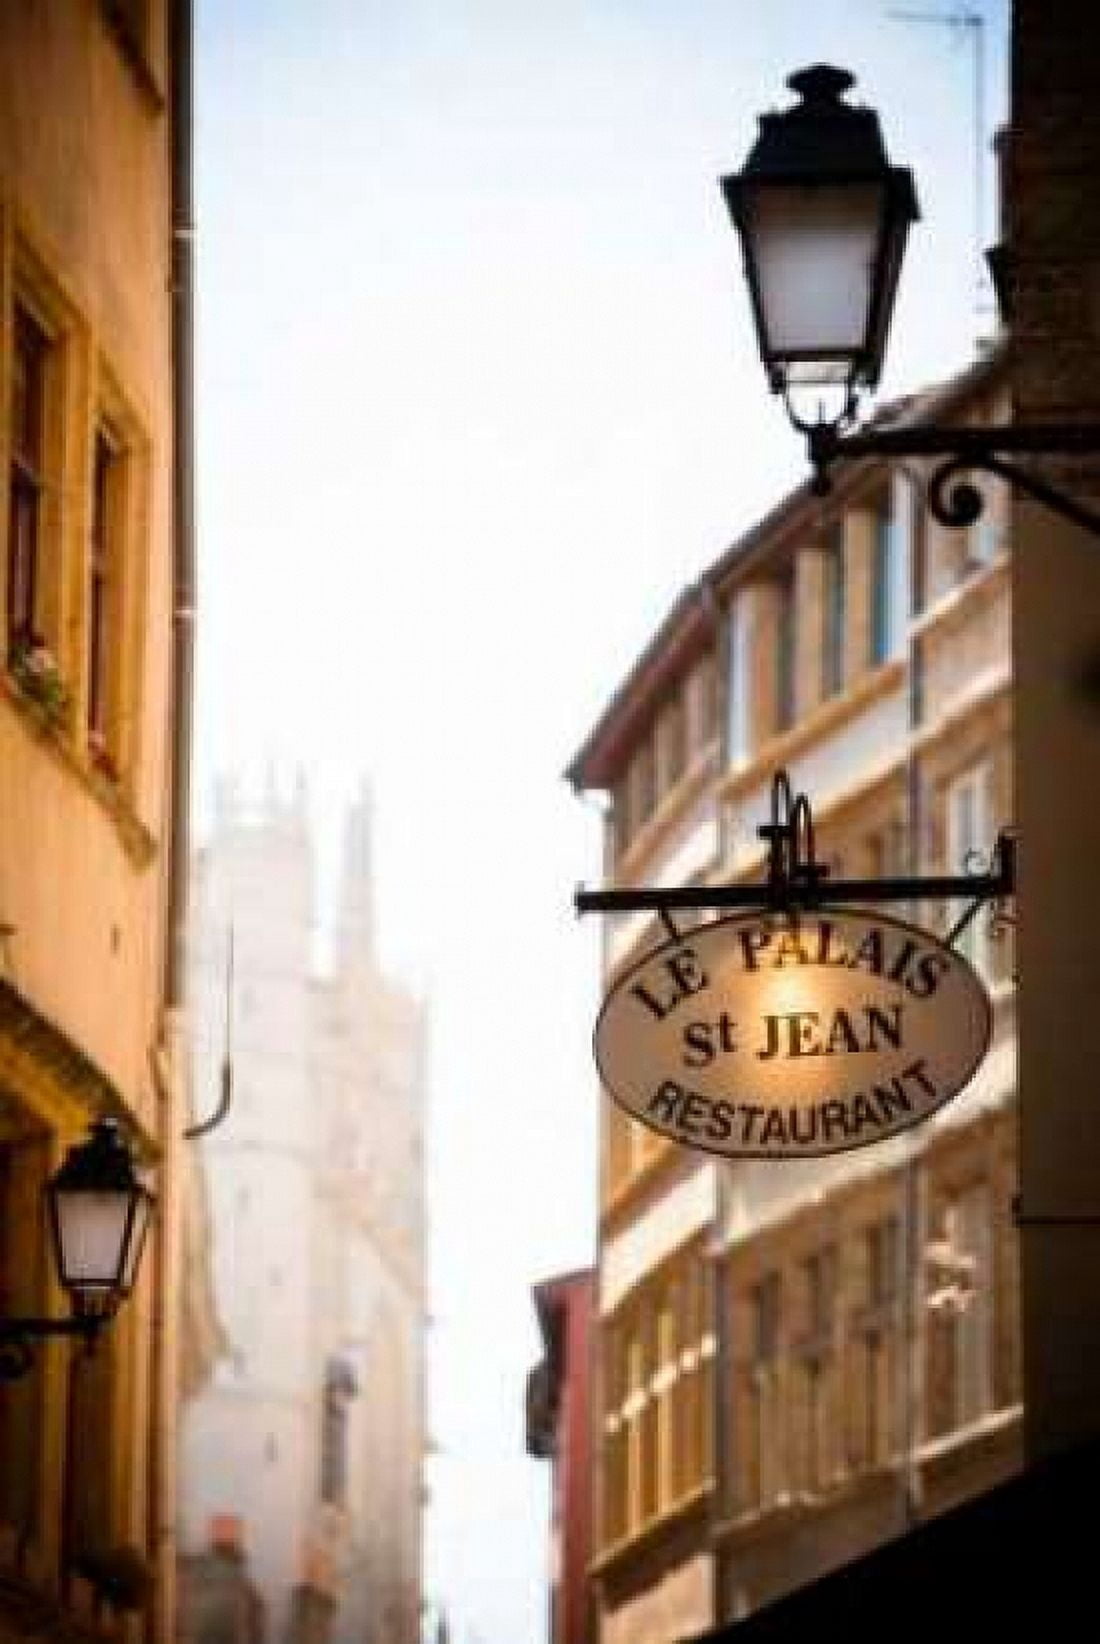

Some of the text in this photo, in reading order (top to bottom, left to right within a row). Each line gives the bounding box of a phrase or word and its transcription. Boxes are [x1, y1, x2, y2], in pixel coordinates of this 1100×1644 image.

[631, 920, 949, 1020] LE PALAIS
[683, 1004, 902, 1067] St JEAN
[649, 1059, 937, 1144] RESTAURANT
